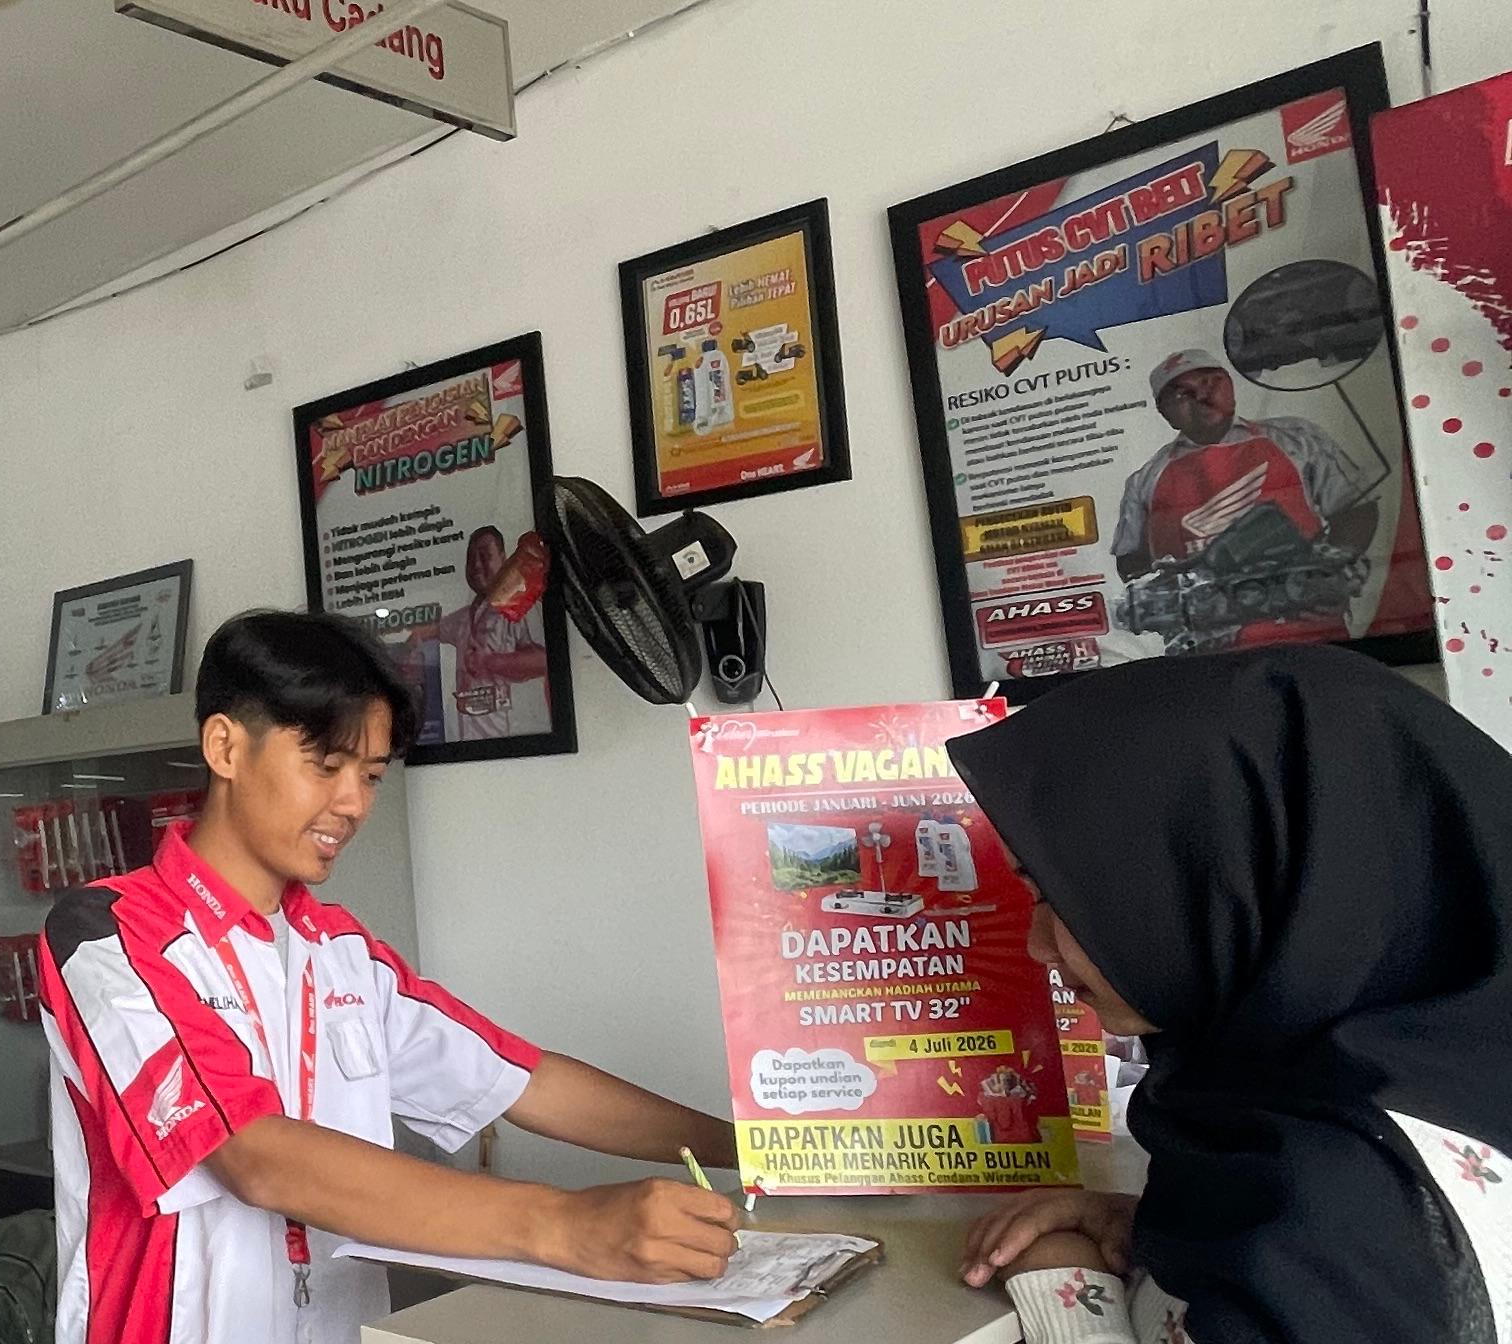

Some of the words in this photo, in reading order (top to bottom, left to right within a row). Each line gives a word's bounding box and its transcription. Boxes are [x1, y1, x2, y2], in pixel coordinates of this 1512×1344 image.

[963, 227, 1065, 295] PUTUS
[1063, 197, 1129, 251] CVT
[1128, 162, 1205, 224] BELT
[939, 278, 1054, 348] URUSAN
[1060, 244, 1127, 298] JADI
[1138, 176, 1294, 284] RIBET
[669, 298, 715, 328] 0.65L
[947, 384, 1010, 410] RESIKO
[1014, 374, 1050, 394] CVT
[355, 436, 490, 490] NITROGEN
[986, 596, 1094, 622] AHASS
[715, 752, 827, 790] AHASS
[741, 799, 809, 816] PERIODE
[813, 796, 878, 812] JANUARI
[891, 793, 927, 809] JUNI
[932, 791, 975, 806] 2026
[187, 873, 227, 920] HONDA
[780, 919, 971, 959] DAPATKAN
[795, 954, 965, 985] KESEMPATAN
[784, 986, 882, 1002] MEMENANGKAN
[886, 983, 933, 997] HADIAH
[936, 980, 982, 995] UTAMA
[799, 1002, 886, 1026] SMART
[891, 1000, 922, 1021] TV
[928, 997, 971, 1020] 32"
[909, 1039, 918, 1053] 4
[924, 1037, 951, 1053] Juli
[956, 1035, 996, 1052] 2026
[1071, 1042, 1099, 1053] 2026
[772, 1057, 845, 1073] Dapatkan
[759, 1073, 806, 1088] kupon
[810, 1071, 862, 1084] undian
[763, 1087, 808, 1102] setiap
[811, 1085, 863, 1098] service
[156, 1100, 206, 1140] HONDA
[749, 1125, 884, 1151] DAPATKAN
[893, 1123, 965, 1149] JUGA
[765, 1153, 836, 1171] HADIAH
[843, 1152, 930, 1171] MENARIK
[934, 1151, 977, 1170] TIAP
[985, 1150, 1052, 1169] BULAN
[779, 1172, 821, 1184] Khusus
[825, 1172, 885, 1187] Pelanggan
[889, 1172, 924, 1184] Ahass
[928, 1172, 980, 1184] Cendana
[983, 1172, 1040, 1184] Wiradesa
